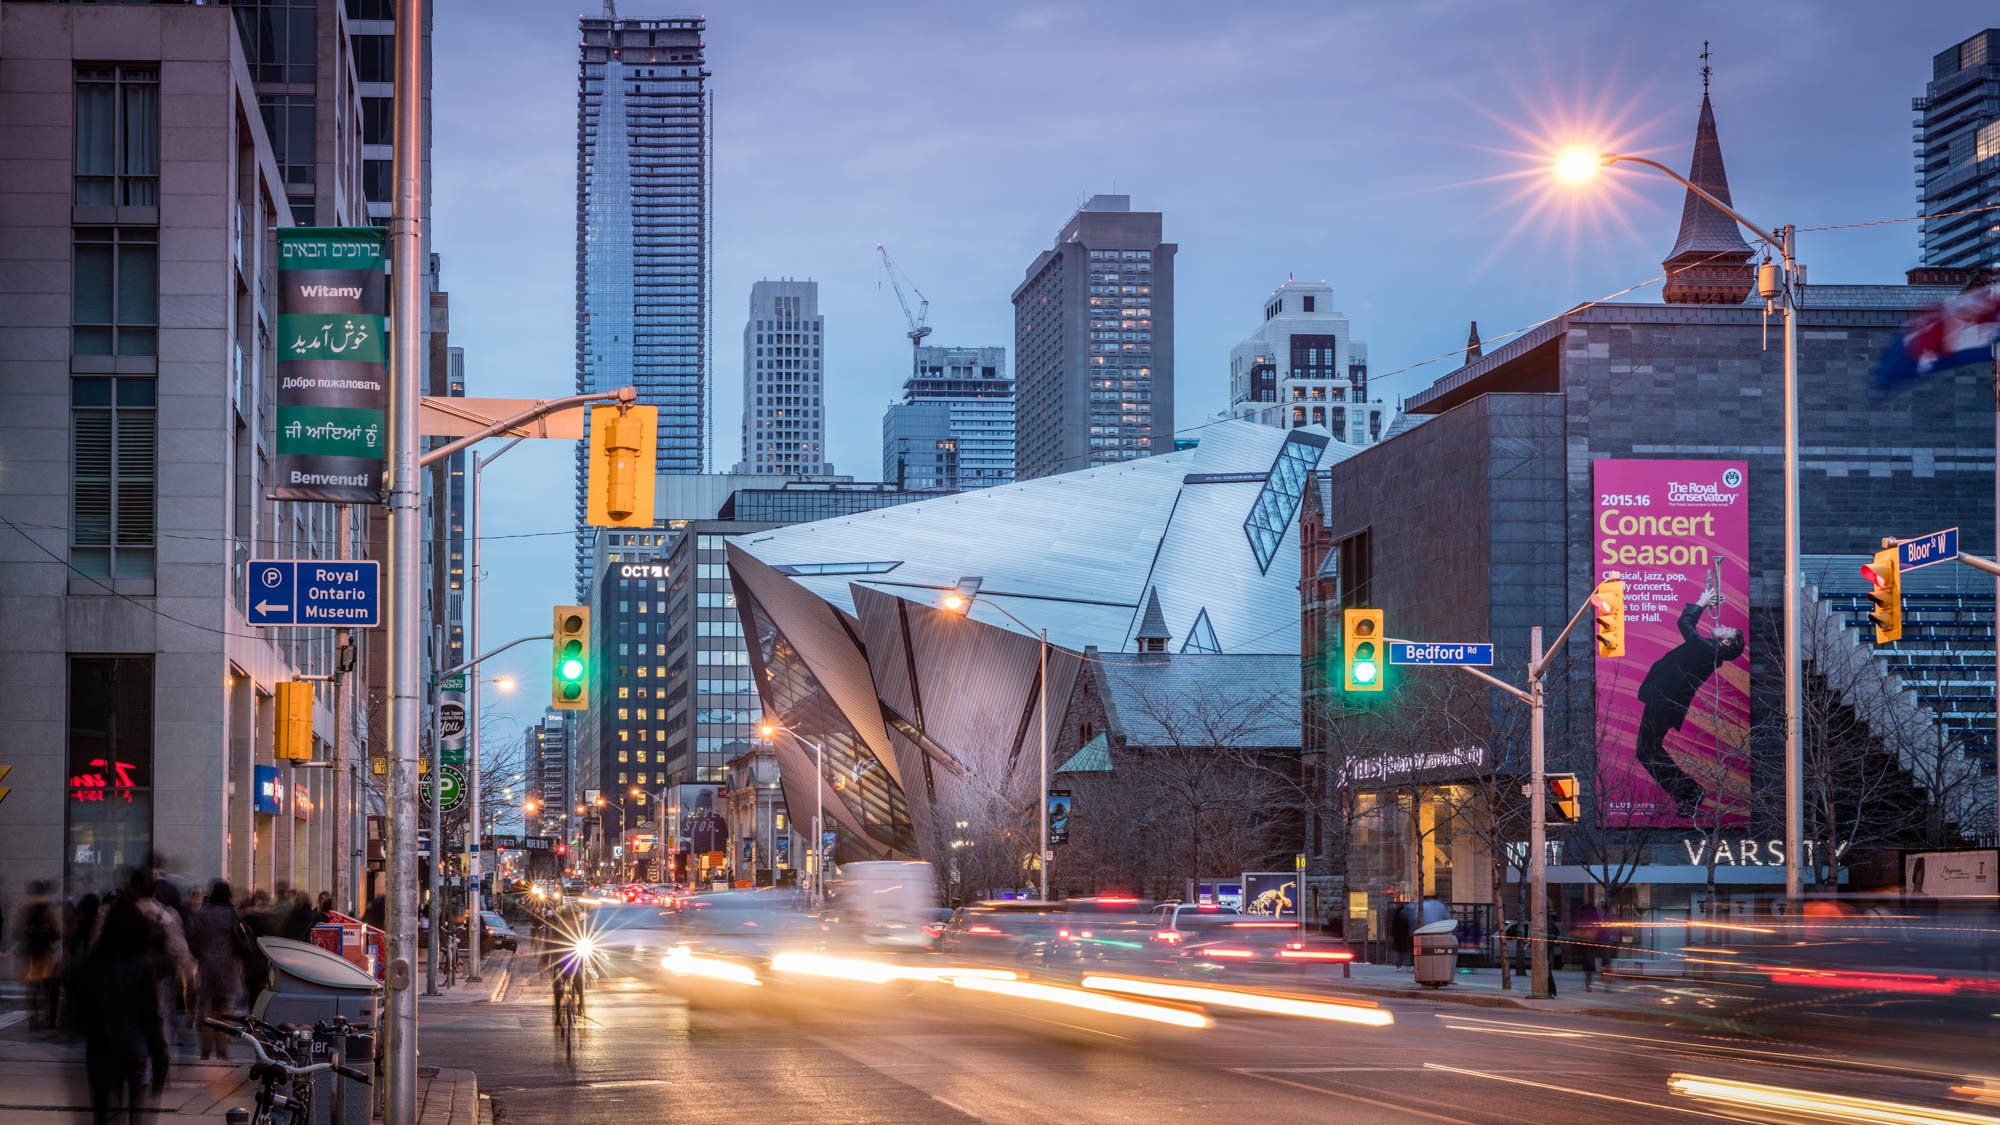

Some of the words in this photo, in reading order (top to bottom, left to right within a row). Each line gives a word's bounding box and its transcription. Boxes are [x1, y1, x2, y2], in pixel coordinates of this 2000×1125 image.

[282, 243, 327, 257] הבאים
[332, 243, 380, 257] ברוכים
[300, 285, 363, 299] Witamy
[330, 320, 368, 353] خوش
[282, 376, 316, 389] Добро
[318, 379, 381, 391] пожаловать
[290, 471, 369, 487] Benvenuti
[1667, 481, 1688, 493] The
[1689, 482, 1717, 495] Royal
[1601, 494, 1650, 506] 2015.16
[1600, 509, 1715, 536] Concert
[1601, 538, 1708, 566] Season
[1908, 542, 1931, 562] Bloor
[1938, 534, 1946, 554] W
[316, 569, 359, 585] Royal
[1602, 571, 1642, 581] Clsical,
[1643, 571, 1665, 582] jazz,
[1666, 573, 1687, 582] pop,
[308, 587, 366, 600] Ontario
[1633, 583, 1673, 591] concerts,
[1623, 592, 1650, 601] world
[1652, 592, 1678, 601] music
[305, 605, 368, 618] Museum
[1641, 603, 1658, 611] life
[1658, 603, 1668, 611] in
[1641, 613, 1662, 622] Hall.
[1406, 645, 1464, 660] Bedford
[1467, 646, 1477, 654] Rd
[1684, 839, 1849, 866] VARSTY
